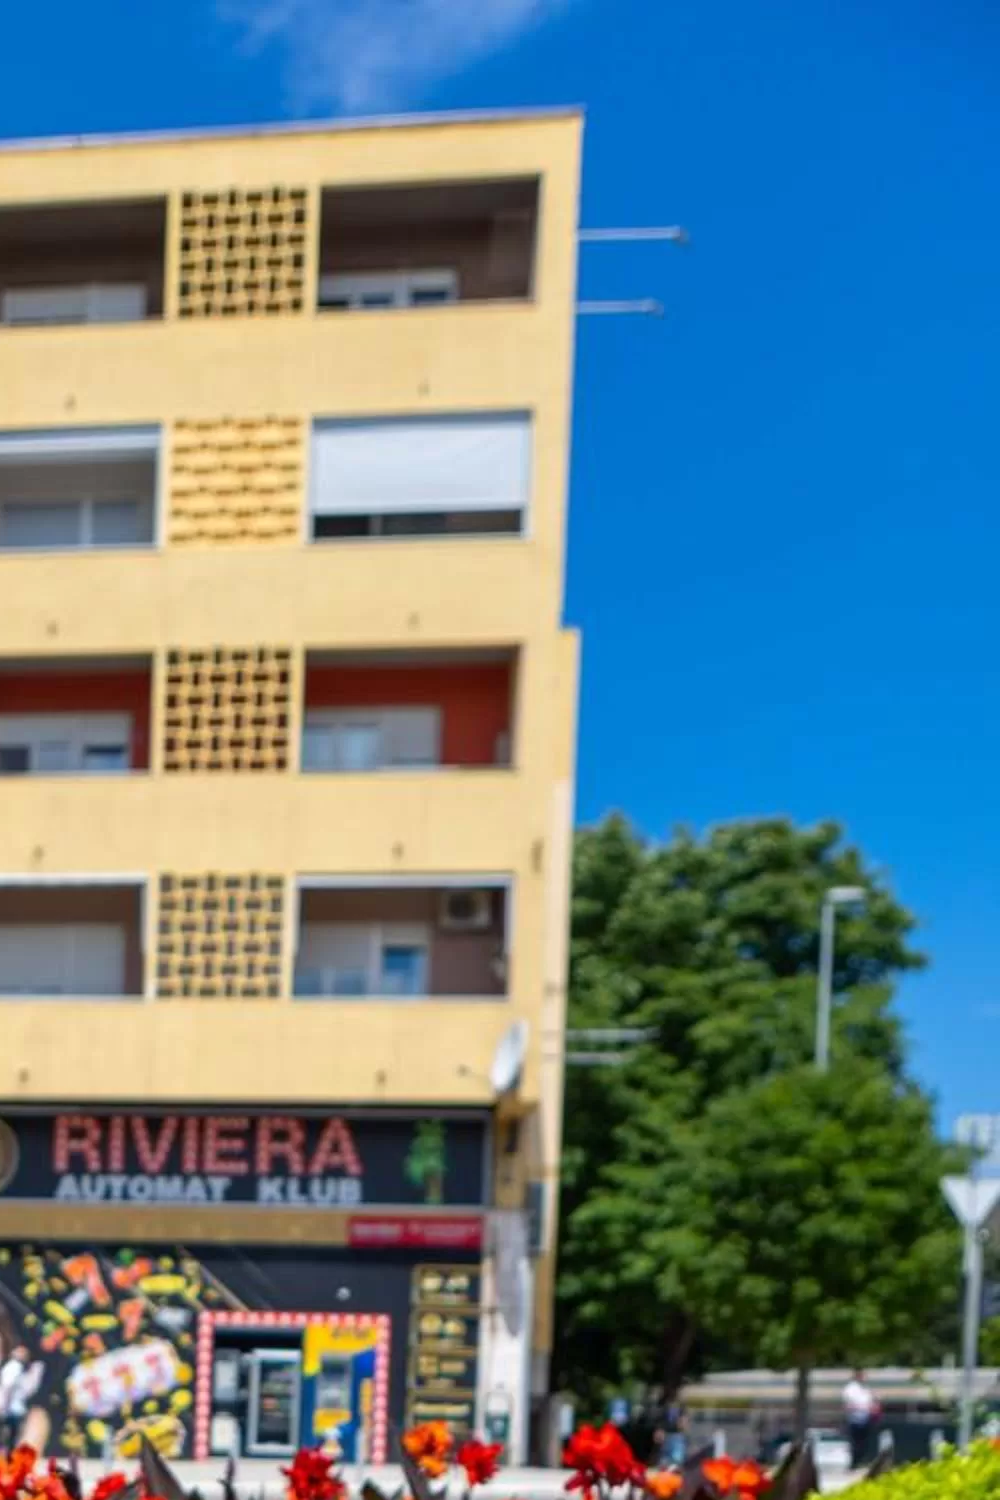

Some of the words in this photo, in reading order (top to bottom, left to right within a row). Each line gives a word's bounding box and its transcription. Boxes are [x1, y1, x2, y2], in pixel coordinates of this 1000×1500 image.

[53, 1115, 364, 1174] RIVIERA
[54, 1175, 232, 1203] AUTOMAT
[257, 1177, 361, 1206] KLUB
